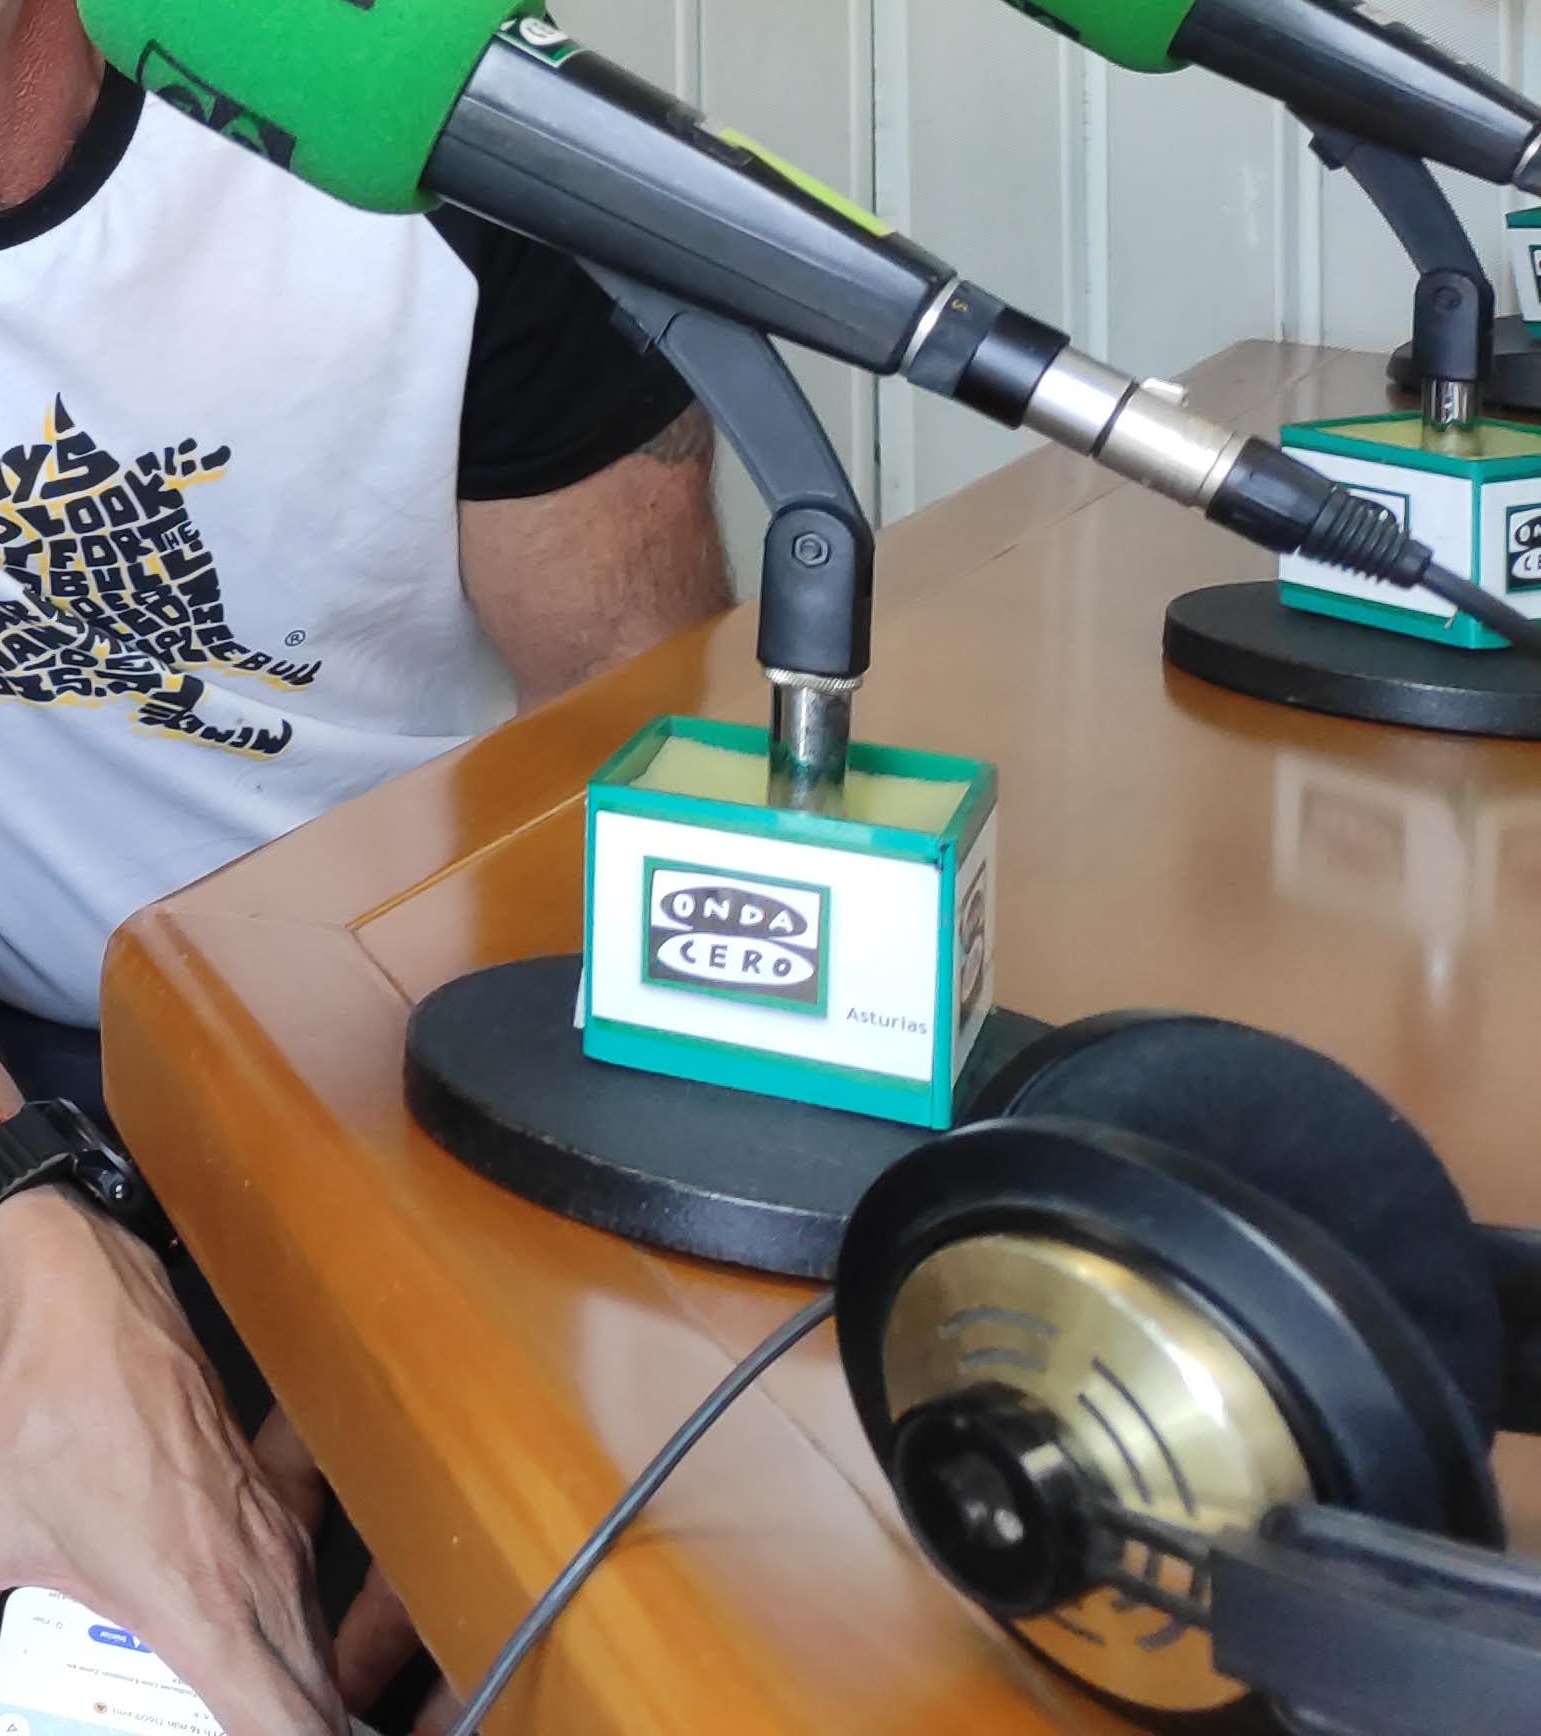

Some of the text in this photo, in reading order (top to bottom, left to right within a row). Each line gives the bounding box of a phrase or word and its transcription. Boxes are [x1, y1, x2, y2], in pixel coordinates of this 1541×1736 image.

[17, 470, 185, 539] LOOK
[49, 507, 201, 569] FOR THE
[672, 892, 794, 934] ONDA
[679, 938, 793, 978] CERO
[845, 1006, 928, 1035] Asturias
